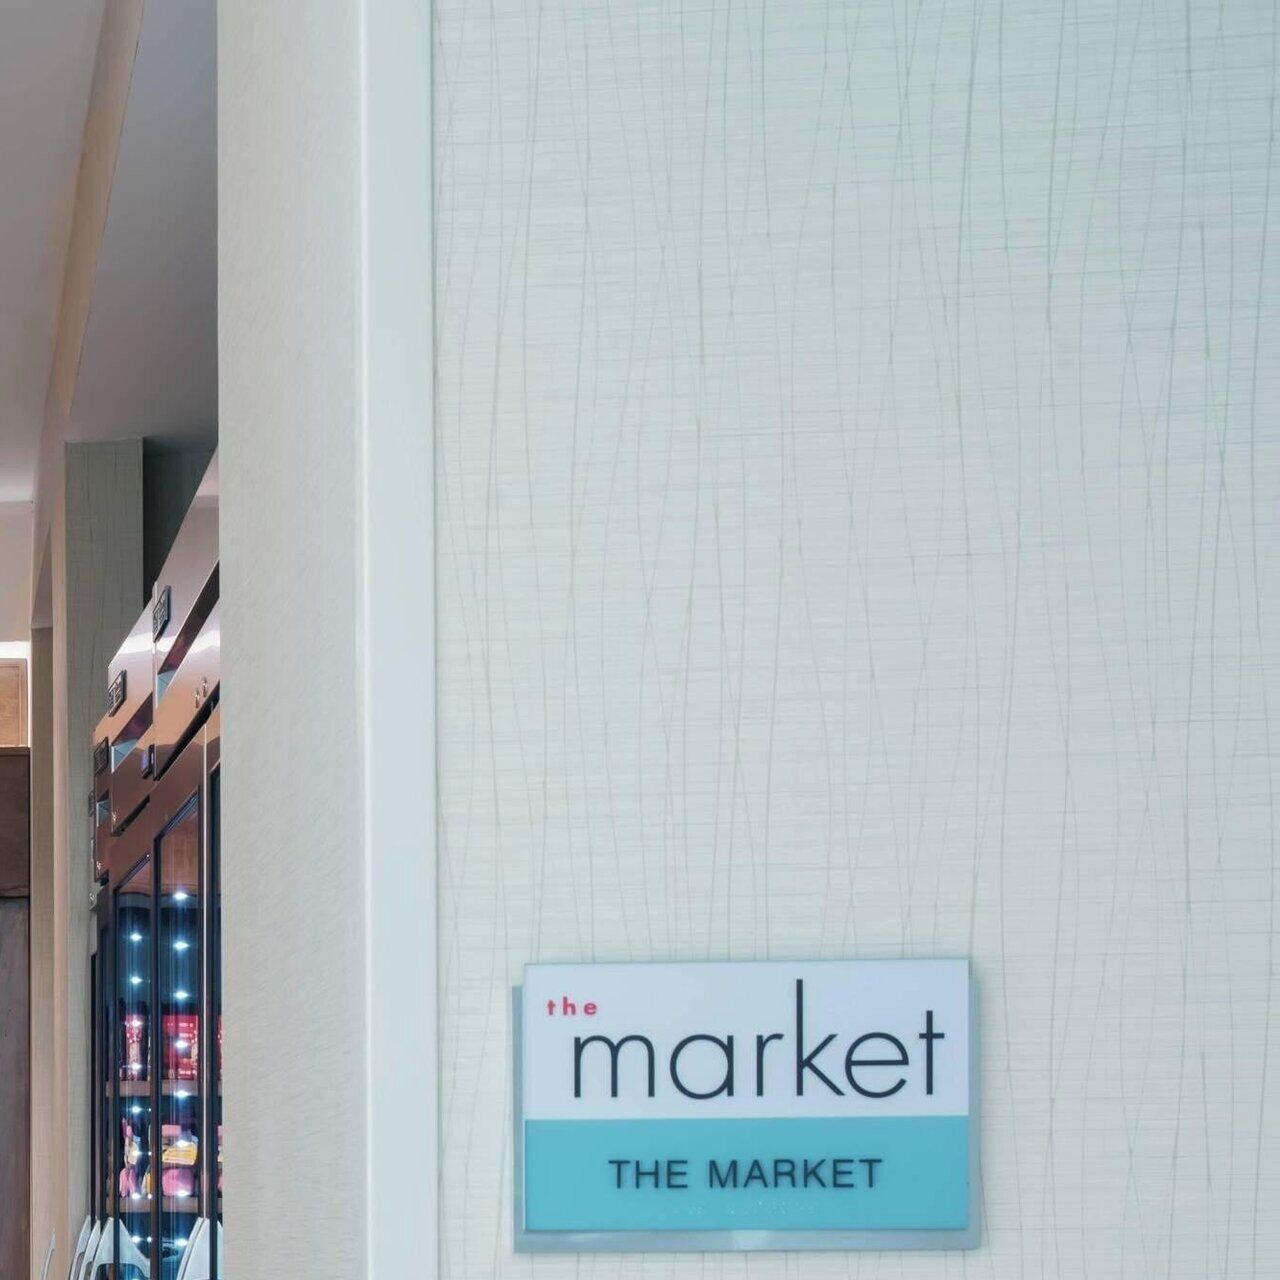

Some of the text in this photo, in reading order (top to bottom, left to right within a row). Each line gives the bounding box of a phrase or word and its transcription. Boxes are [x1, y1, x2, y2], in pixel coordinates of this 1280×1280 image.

[547, 996, 598, 1016] the
[573, 978, 946, 1100] market
[608, 1158, 883, 1190] THE MARKET
